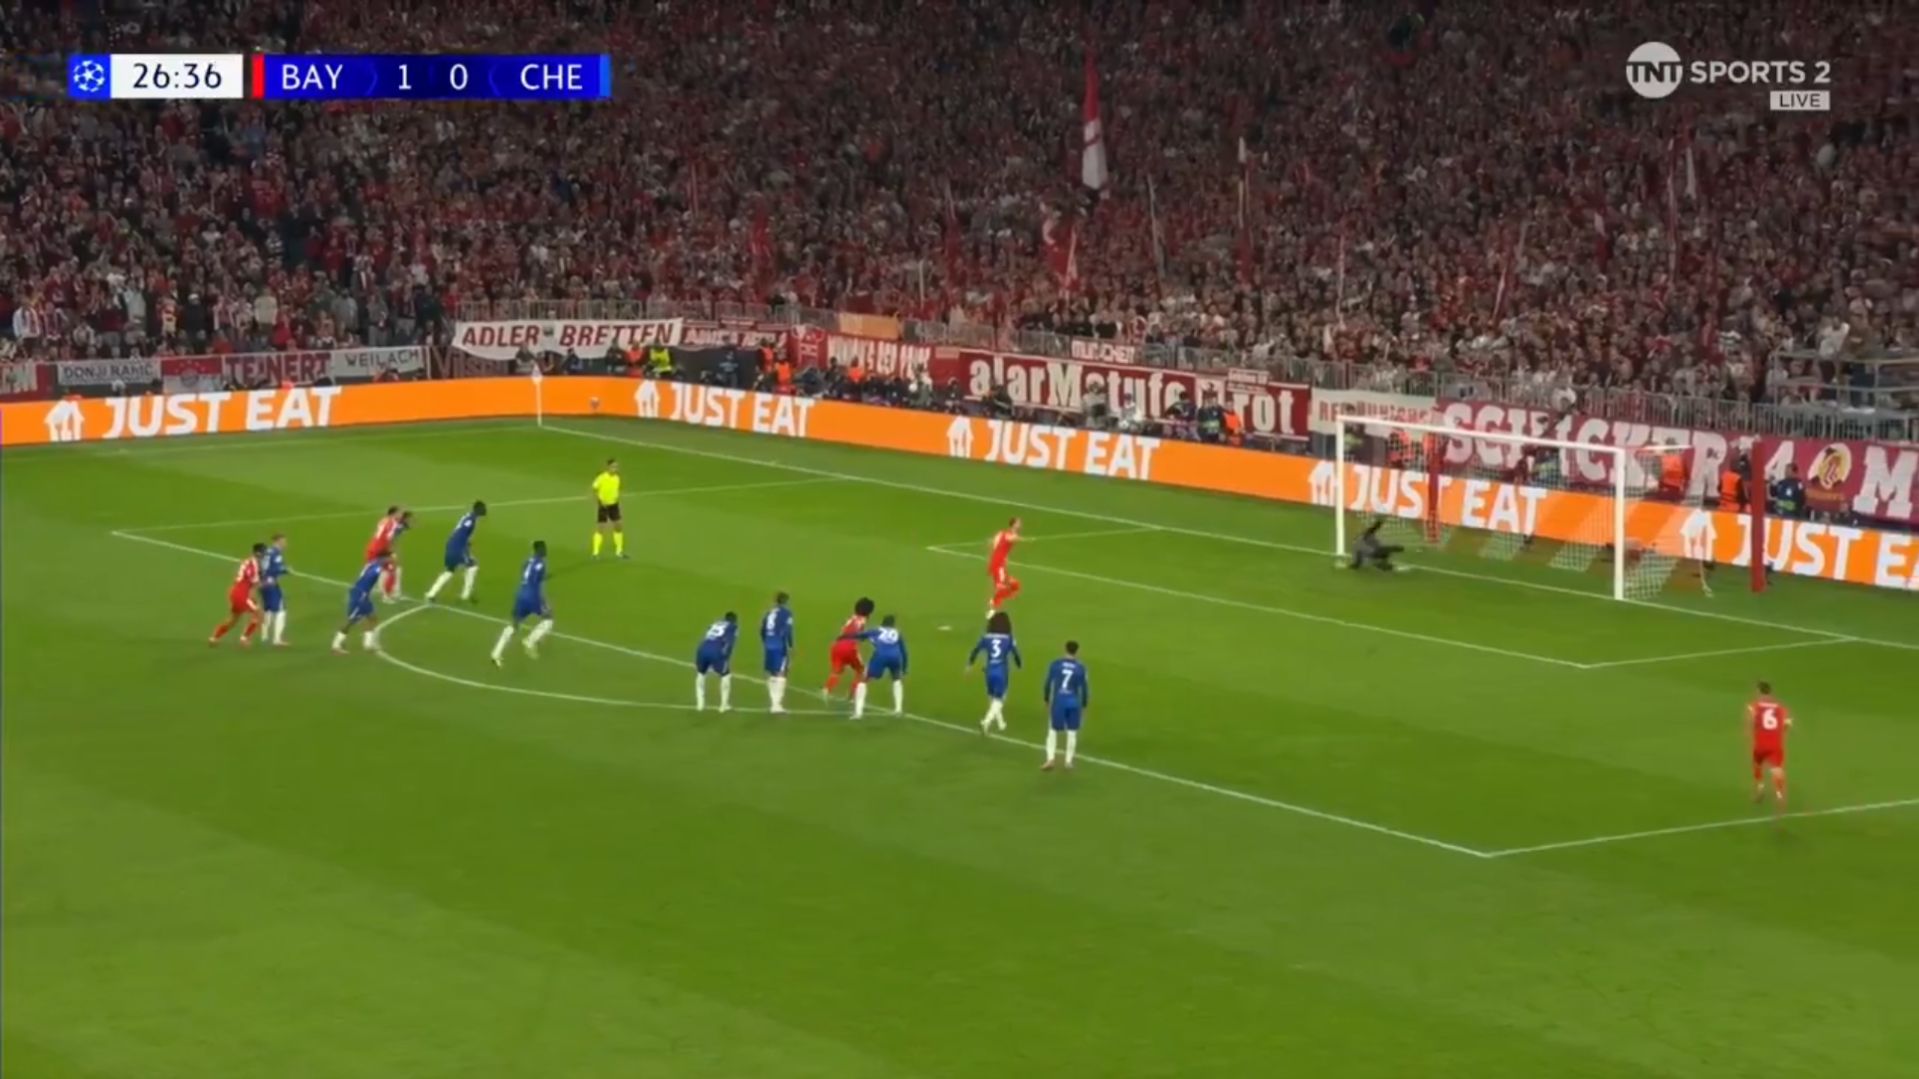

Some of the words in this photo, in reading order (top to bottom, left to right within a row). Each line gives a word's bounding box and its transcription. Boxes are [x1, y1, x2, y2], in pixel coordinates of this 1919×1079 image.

[461, 324, 541, 348] ADLER
[559, 321, 674, 347] BRETTEN
[344, 348, 420, 367] WEILACH
[102, 392, 232, 440] JUST
[245, 386, 342, 431] EAT
[671, 382, 748, 428] JUST
[753, 395, 815, 438] EAT
[986, 420, 1077, 470] JUST
[1084, 431, 1161, 480] EAT
[1462, 479, 1548, 535] EAT
[1731, 514, 1862, 580] JUST
[991, 639, 1002, 658] 3
[1062, 668, 1074, 689] 7
[1762, 708, 1778, 730] 6
